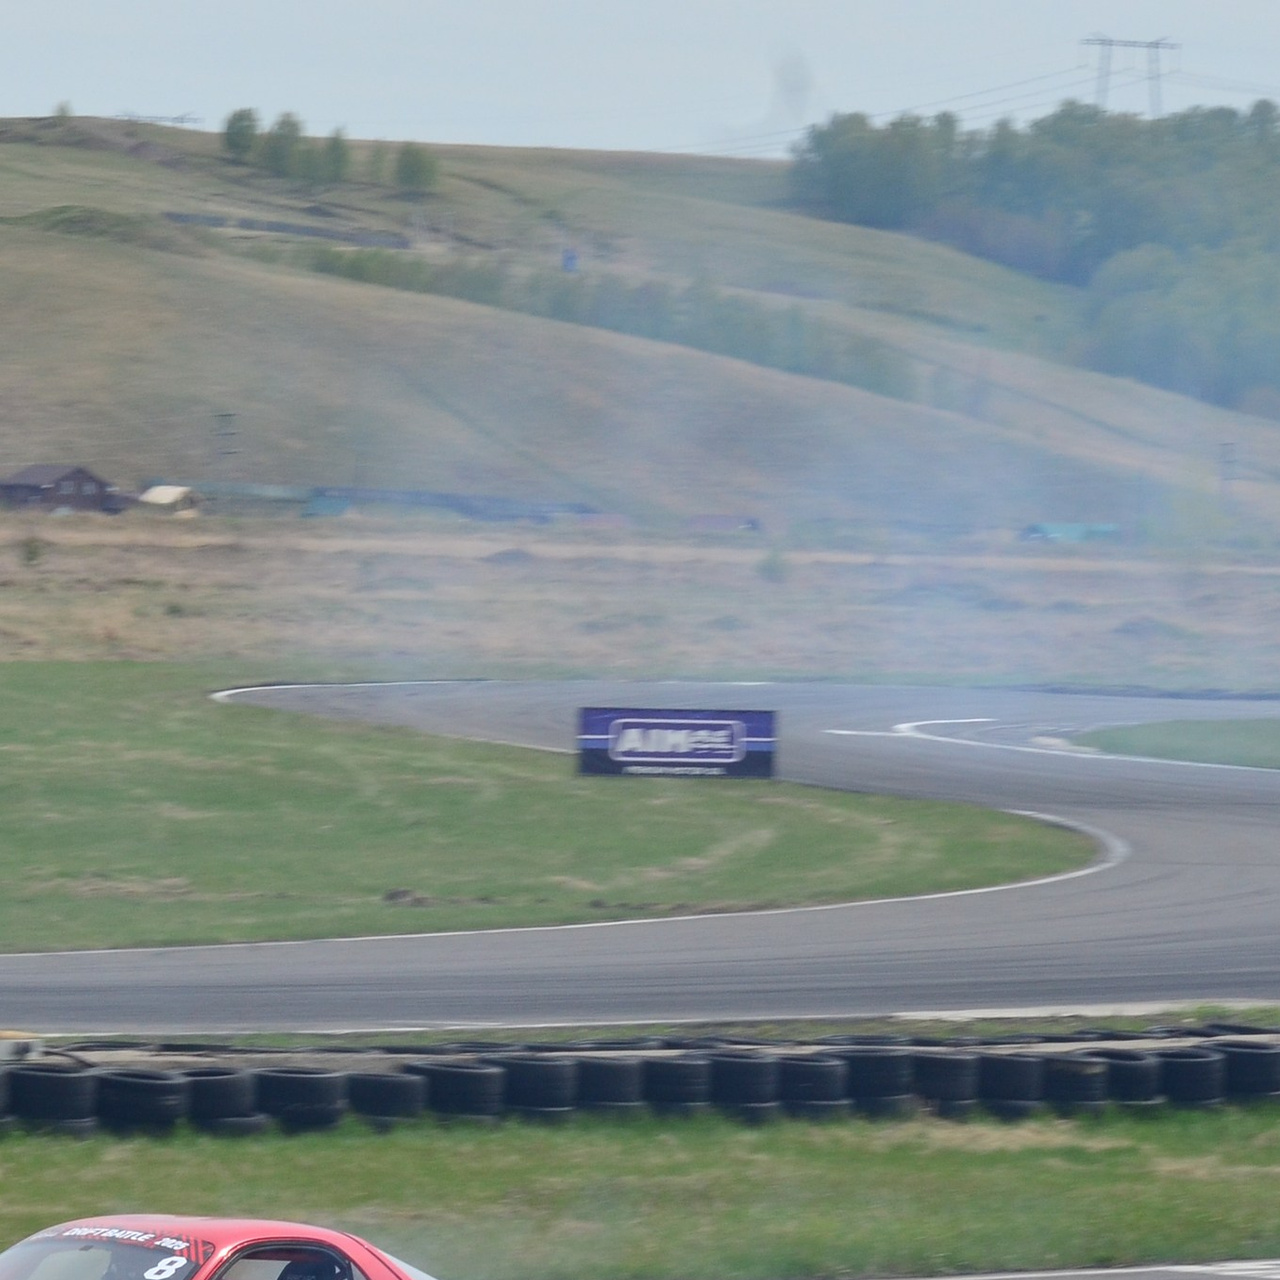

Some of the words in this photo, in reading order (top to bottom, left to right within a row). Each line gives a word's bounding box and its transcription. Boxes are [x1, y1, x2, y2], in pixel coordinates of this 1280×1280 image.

[62, 1227, 109, 1237] DRIFT
[103, 1228, 155, 1242] BATTLE
[143, 1255, 188, 1280] 8
